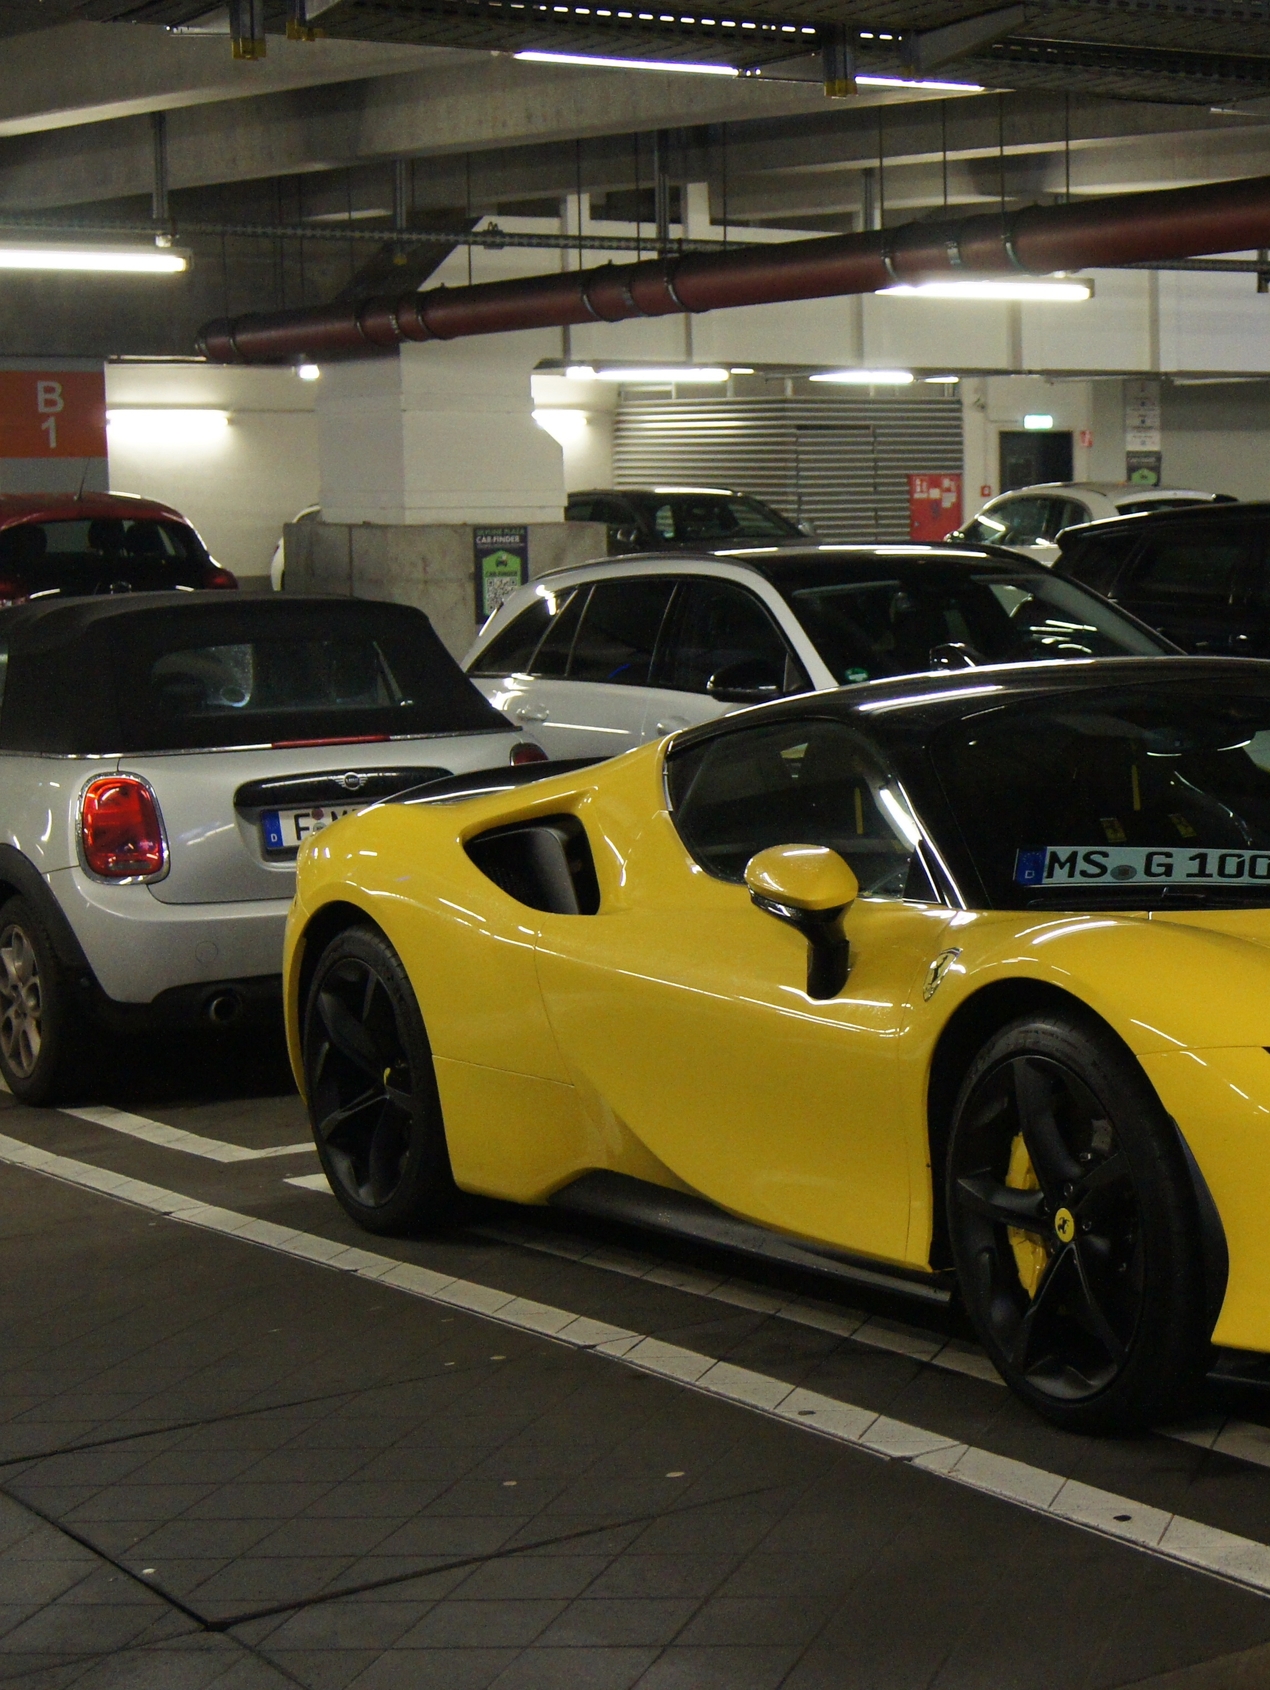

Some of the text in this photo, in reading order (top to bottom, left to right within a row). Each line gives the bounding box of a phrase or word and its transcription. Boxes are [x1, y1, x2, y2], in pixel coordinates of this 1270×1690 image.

[37, 380, 65, 413] B
[41, 416, 57, 449] 1
[270, 834, 278, 842] D
[294, 812, 311, 841] F
[1045, 850, 1110, 879] MS
[1143, 850, 1174, 878] G
